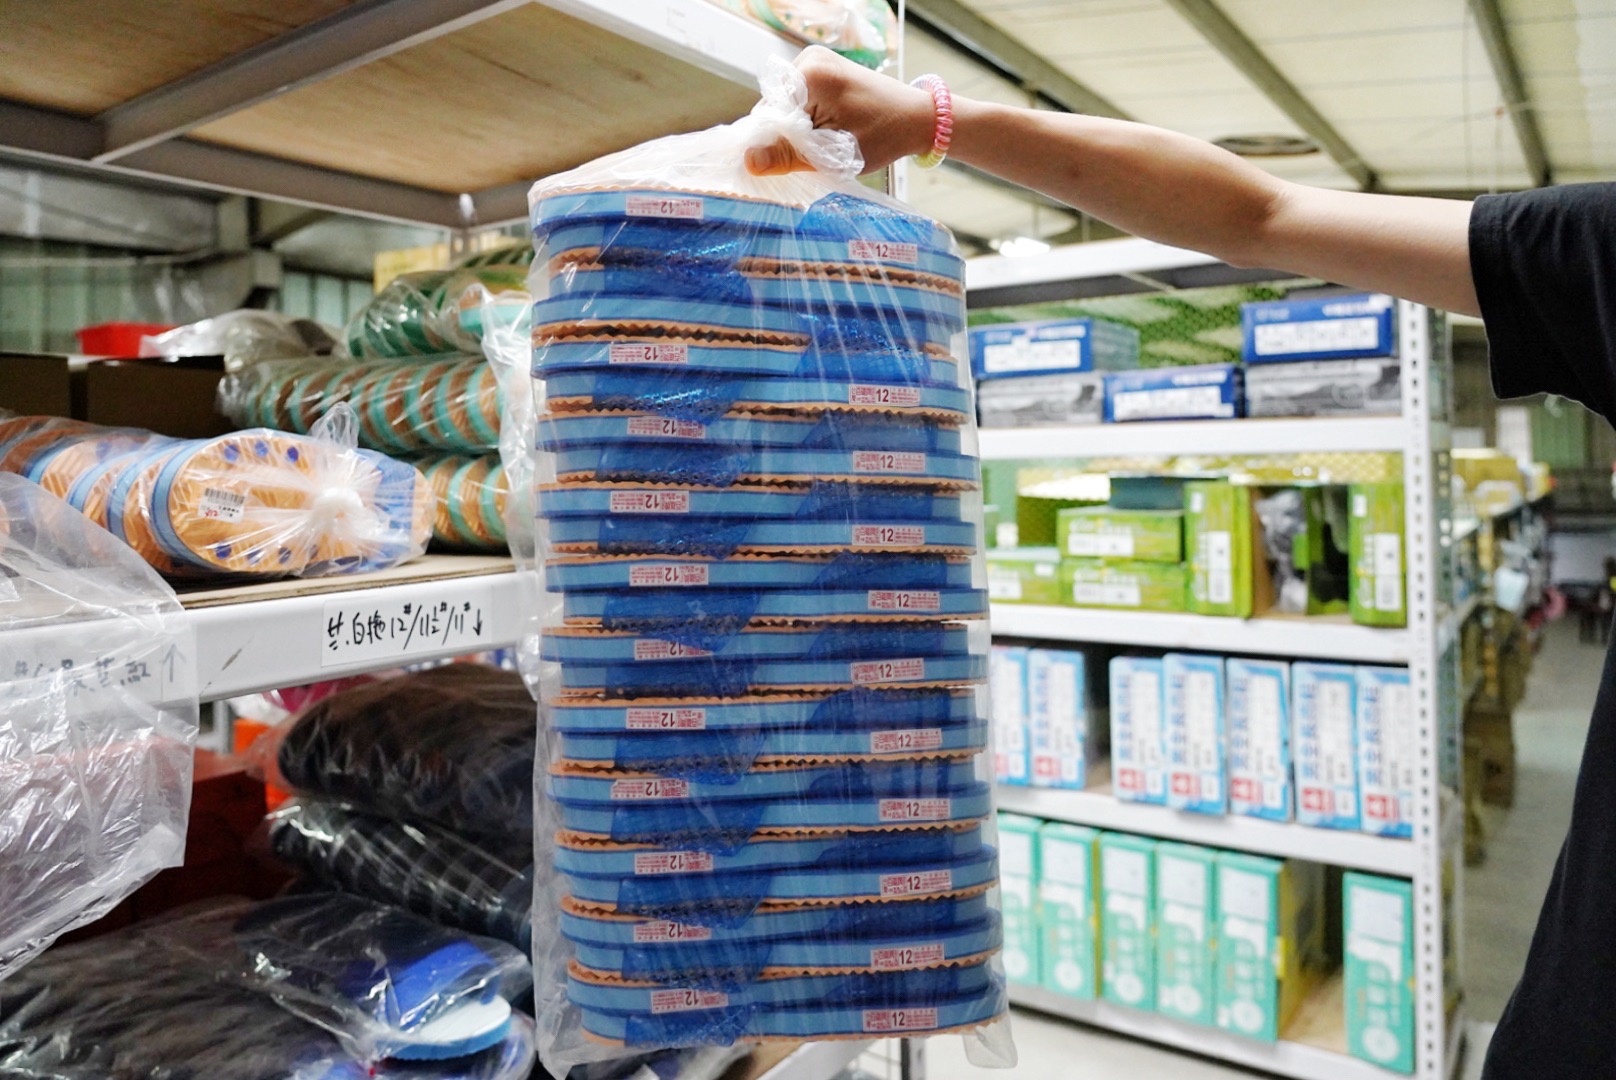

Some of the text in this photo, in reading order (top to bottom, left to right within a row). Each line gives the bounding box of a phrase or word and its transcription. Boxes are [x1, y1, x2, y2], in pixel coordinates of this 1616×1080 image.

[660, 201, 674, 215] 12
[876, 244, 888, 258] 12
[644, 346, 660, 361] 12
[875, 389, 889, 403] 12
[662, 420, 677, 435] 12
[880, 455, 894, 469] 12
[645, 494, 660, 509] 12
[880, 528, 894, 542] 12
[664, 567, 679, 582] 12
[896, 594, 910, 608] 12
[669, 642, 684, 656] 12
[878, 664, 892, 678] 12
[661, 713, 676, 727] 12
[898, 734, 912, 748] 12
[645, 782, 660, 796] 12
[906, 802, 920, 817] 12
[670, 855, 684, 870] 12
[907, 876, 921, 890] 12
[668, 924, 683, 938] 12
[898, 950, 912, 964] 12
[685, 991, 699, 1006] 12
[891, 1012, 905, 1026] 12
